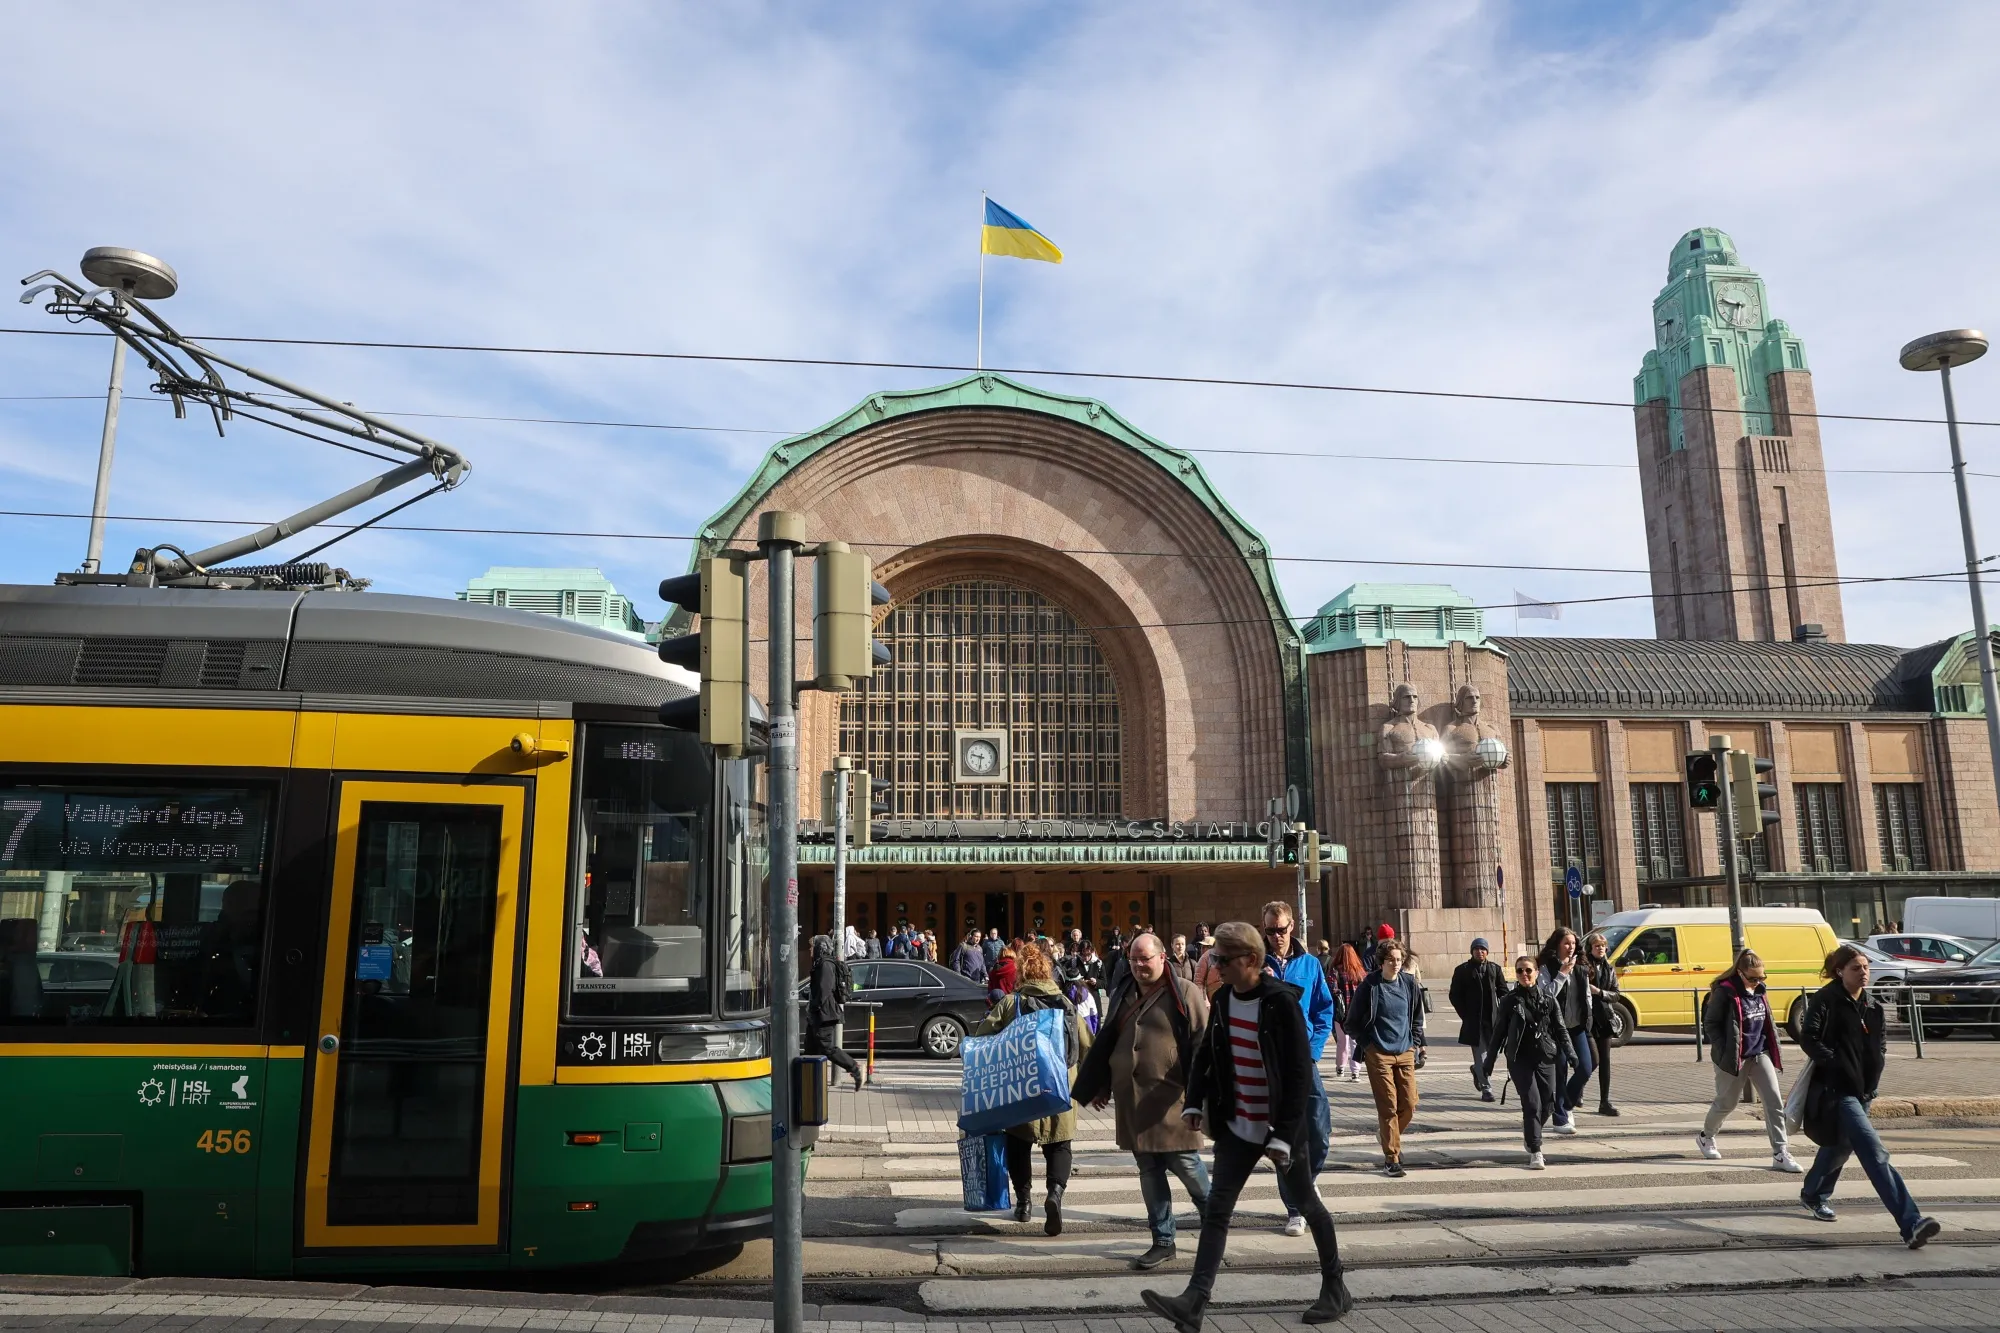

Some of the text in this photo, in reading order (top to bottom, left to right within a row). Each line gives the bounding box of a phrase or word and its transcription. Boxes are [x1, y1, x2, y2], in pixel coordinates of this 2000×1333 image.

[621, 742, 656, 759] 186
[64, 803, 244, 829] Vallgård depå
[2, 800, 42, 861] 7
[59, 836, 238, 862] via Kronohagen
[624, 1034, 651, 1045] HSL
[624, 1045, 651, 1057] HRT
[963, 1032, 1037, 1070] LIVING
[962, 1051, 1037, 1080] SCANDINAVIAN
[962, 1061, 1039, 1095] SLEEPING
[182, 1093, 211, 1105] HRT
[183, 1081, 211, 1093] HSL
[961, 1076, 1041, 1116] LIVING
[196, 1129, 251, 1154] 456
